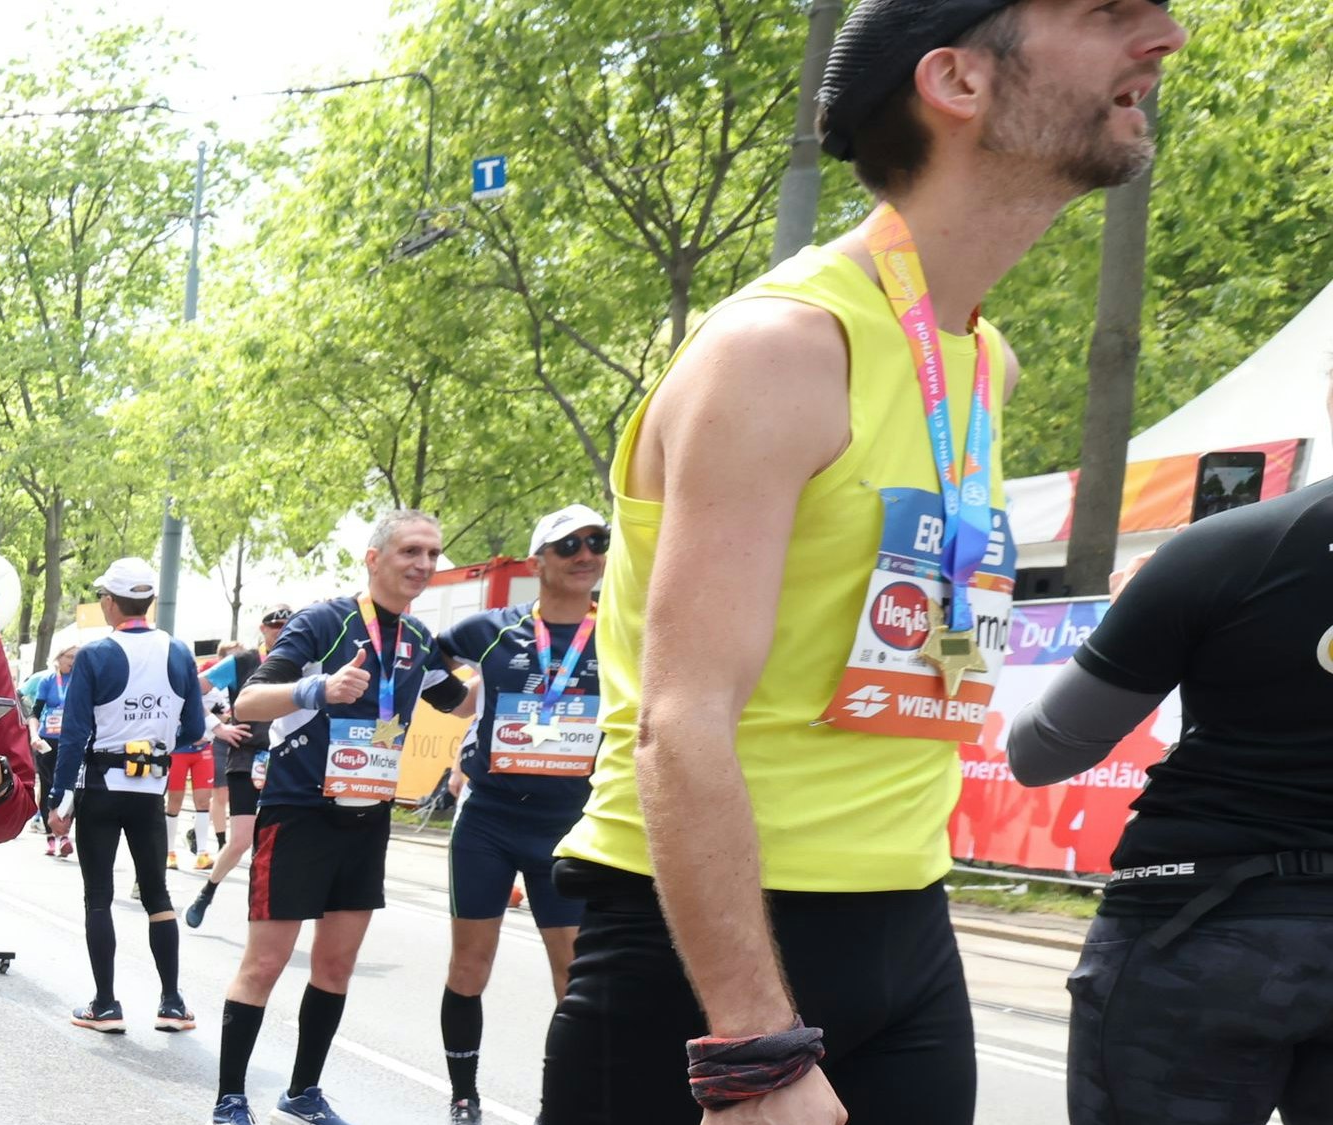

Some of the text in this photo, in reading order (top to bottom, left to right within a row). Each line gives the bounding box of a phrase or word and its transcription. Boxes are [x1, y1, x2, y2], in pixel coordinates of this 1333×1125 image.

[477, 159, 501, 188] T
[915, 320, 952, 481] VIENNA CITY MARATHON
[877, 594, 928, 637] Hervis
[1020, 620, 1097, 649] Du ha
[897, 694, 986, 724] WIEN ENER
[335, 752, 366, 766] Hervis
